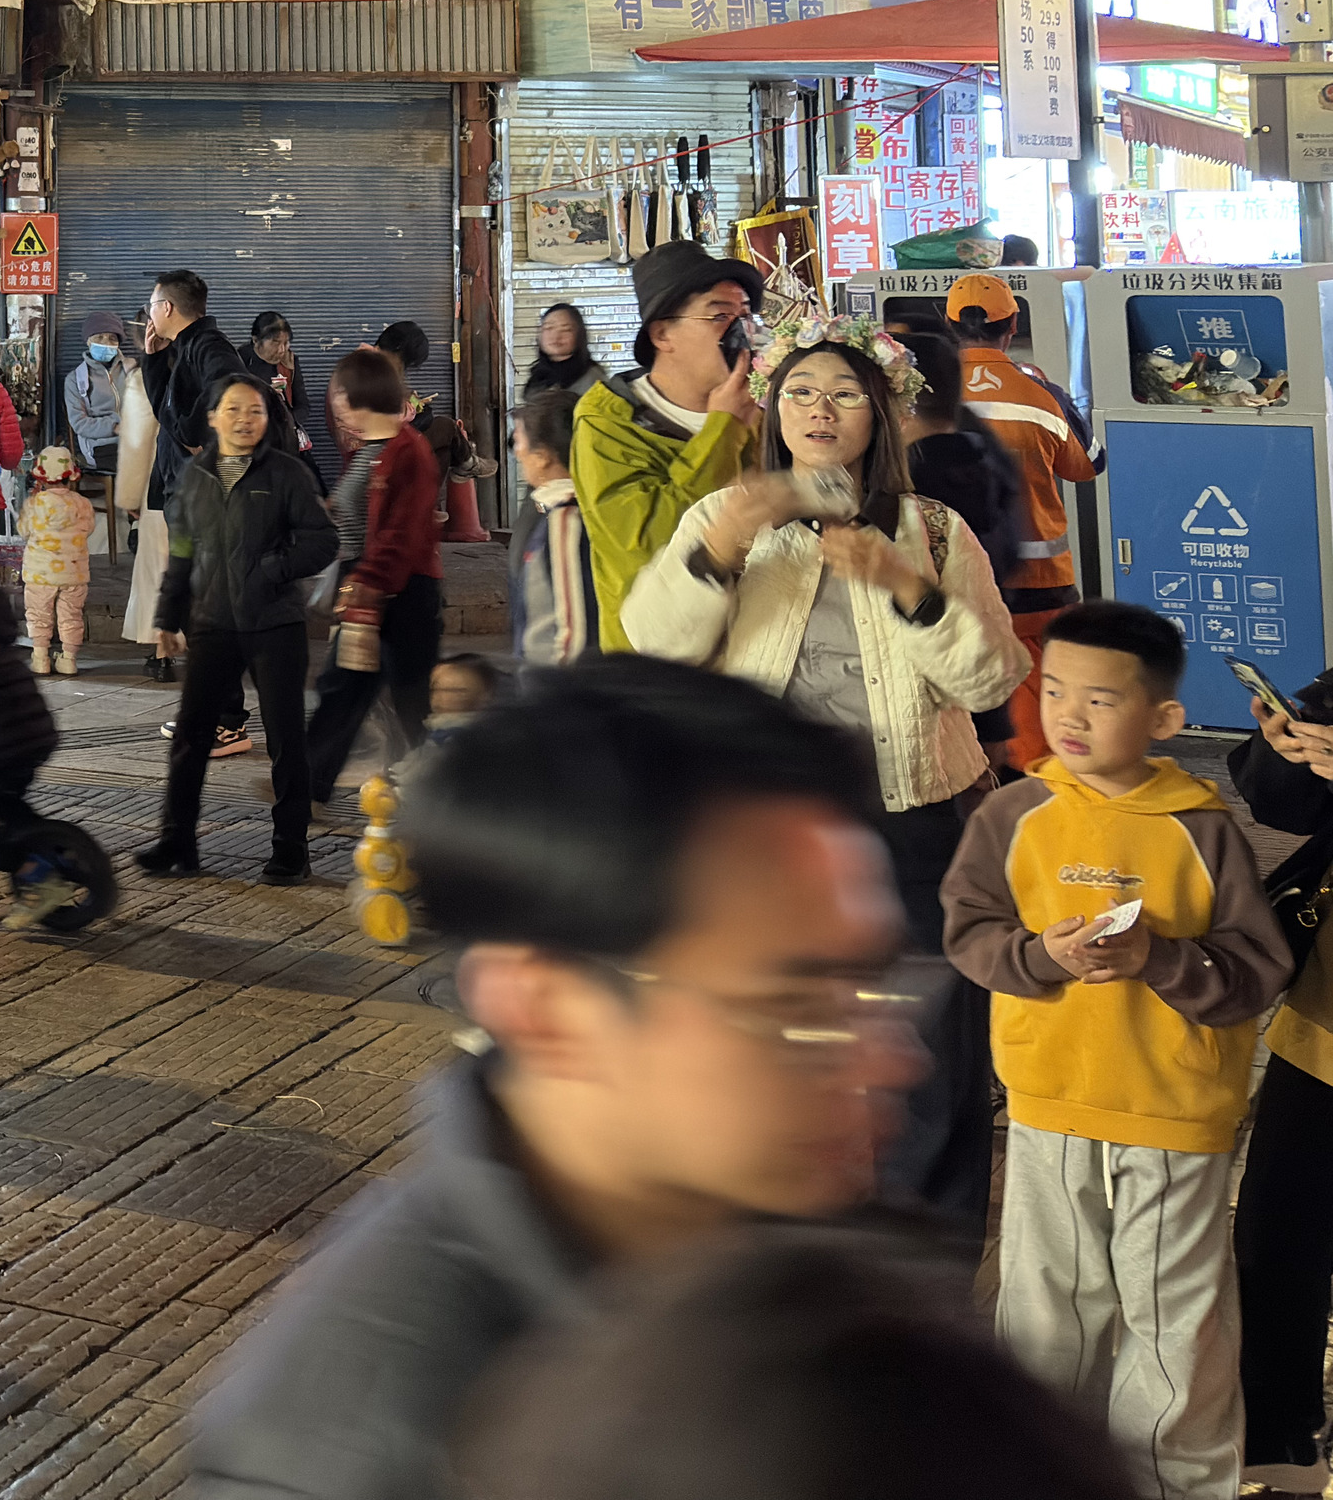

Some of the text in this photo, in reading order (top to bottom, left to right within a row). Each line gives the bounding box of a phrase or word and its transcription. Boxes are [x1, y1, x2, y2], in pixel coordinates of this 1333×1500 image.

[907, 170, 960, 201] 寄存
[830, 183, 874, 275] 刻章
[910, 207, 962, 237] 行李
[7, 260, 52, 272] 小心危房
[7, 275, 52, 286] 请勿靠近
[879, 273, 1028, 292] 垃圾分类箱
[1122, 272, 1283, 291] 垃圾分类收集箱
[1196, 317, 1235, 339] 推
[1181, 542, 1249, 558] 可回收物
[1190, 558, 1243, 569] Recyclable
